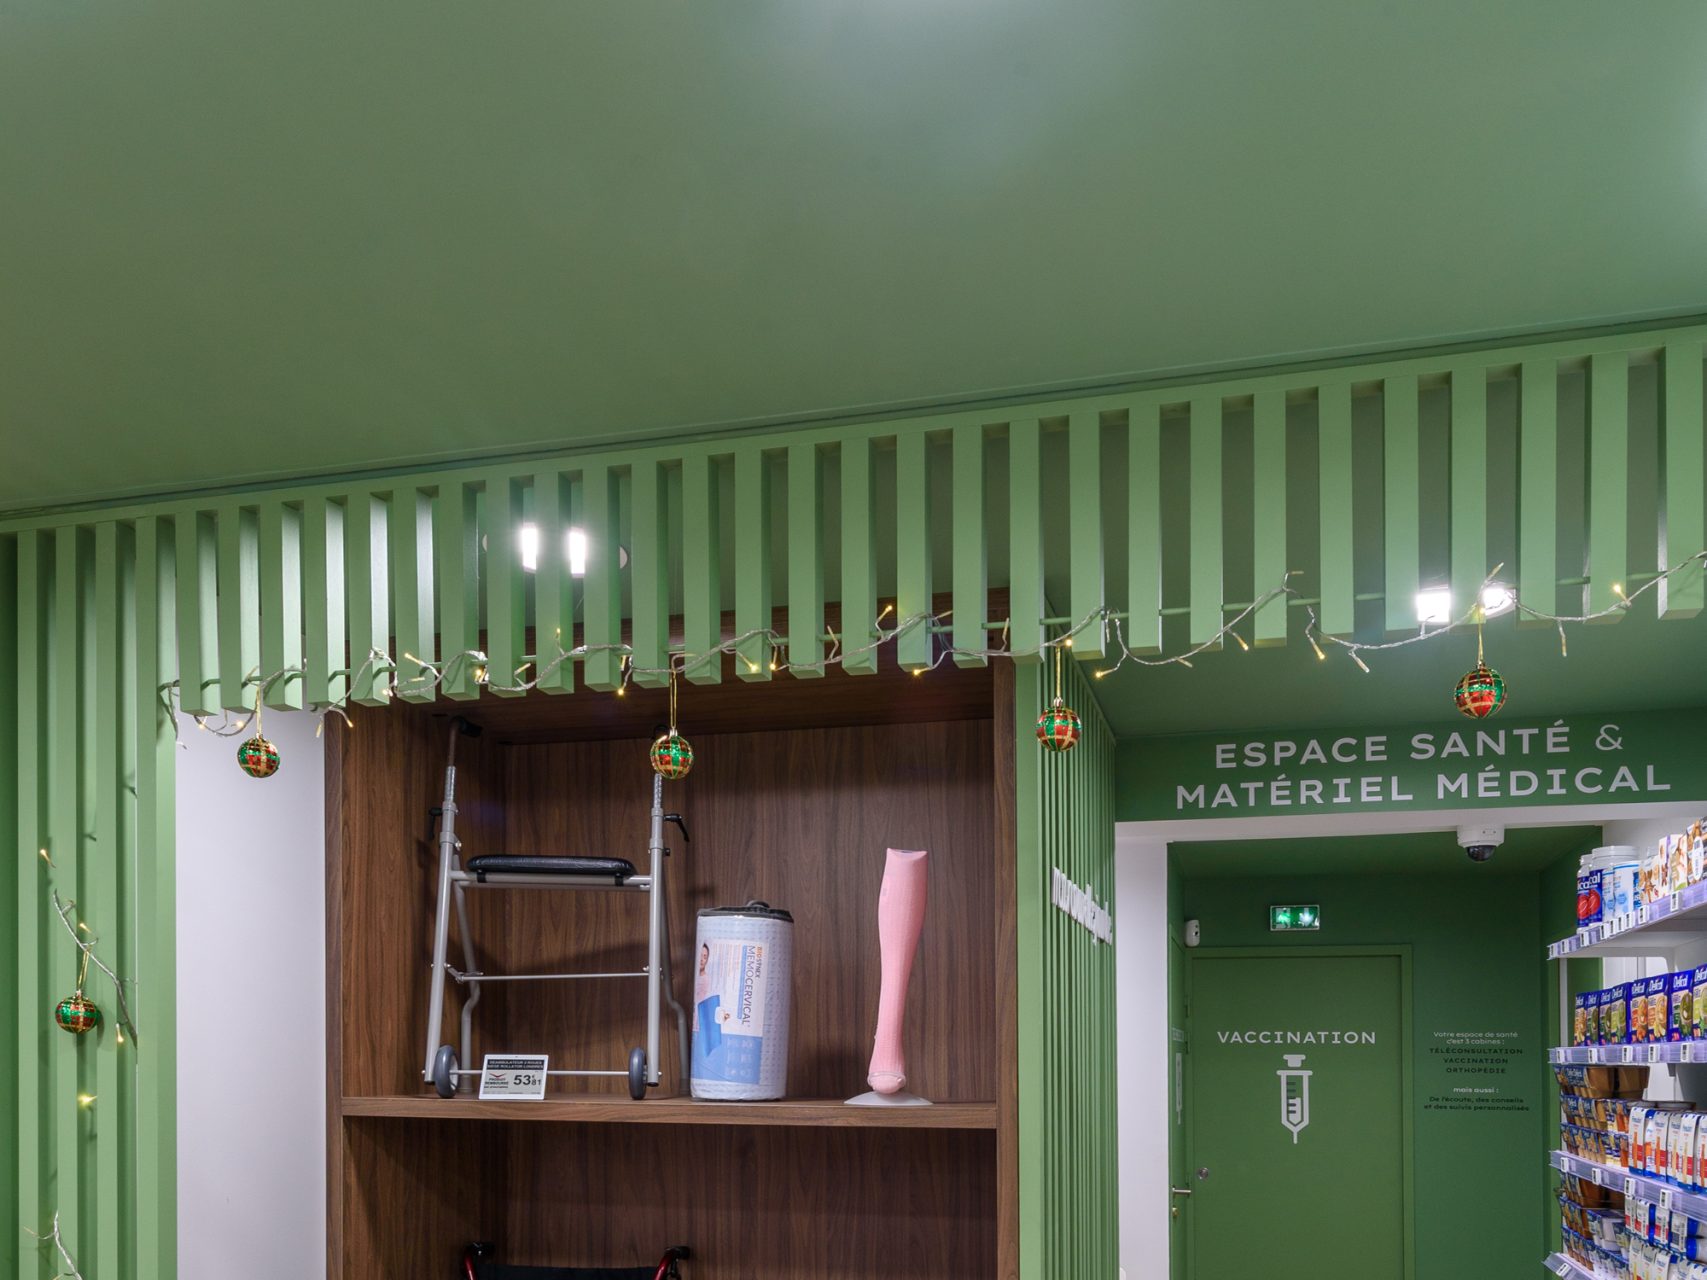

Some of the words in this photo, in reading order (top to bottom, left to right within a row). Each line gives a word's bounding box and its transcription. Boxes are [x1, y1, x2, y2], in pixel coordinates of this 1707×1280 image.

[1215, 735, 1388, 769] ESPACE
[1410, 719, 1571, 760] SANTÉ
[1595, 724, 1624, 751] &
[1176, 773, 1414, 810] MATÉRIEL
[1436, 764, 1671, 800] MÉDICAL
[742, 945, 756, 1024] MEMOCERVICAL
[1217, 1031, 1376, 1044] VACCINATION
[513, 1074, 531, 1086] 53
